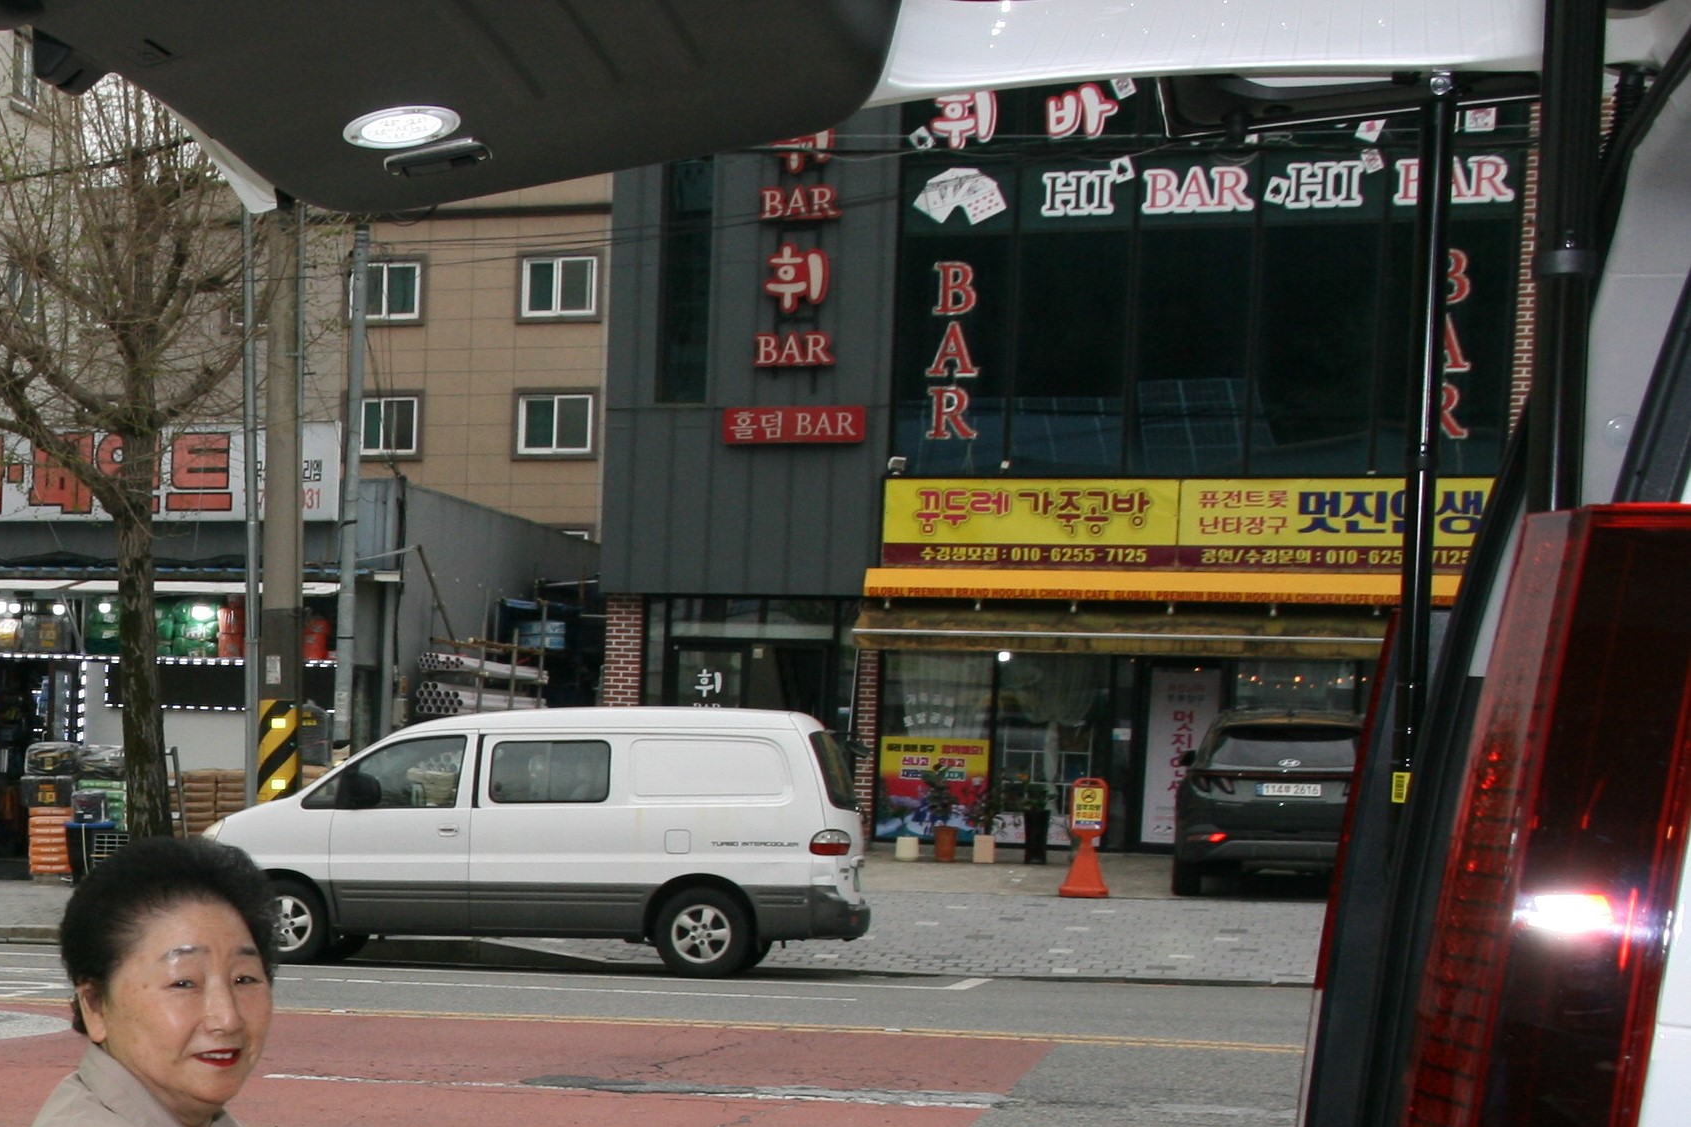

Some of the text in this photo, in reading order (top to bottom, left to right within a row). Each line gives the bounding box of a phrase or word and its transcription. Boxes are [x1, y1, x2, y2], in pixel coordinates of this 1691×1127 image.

[760, 185, 842, 220] BAR
[1041, 171, 1113, 216] HI
[1142, 166, 1255, 214] BAR
[1286, 160, 1363, 208] HI
[764, 243, 830, 314] 휘
[753, 331, 835, 368] BAR
[927, 261, 979, 440] BAR
[729, 411, 857, 440] 홀덤 BAR
[1016, 487, 1151, 536] 가죽공방
[1198, 515, 1289, 535] 난타장구
[1010, 547, 1148, 564] 010-6255-7125
[868, 586, 904, 597] GLOBAL
[909, 587, 953, 597] PREMIUM
[1039, 588, 1083, 599] CHICKEN
[1085, 589, 1110, 599] CAFE
